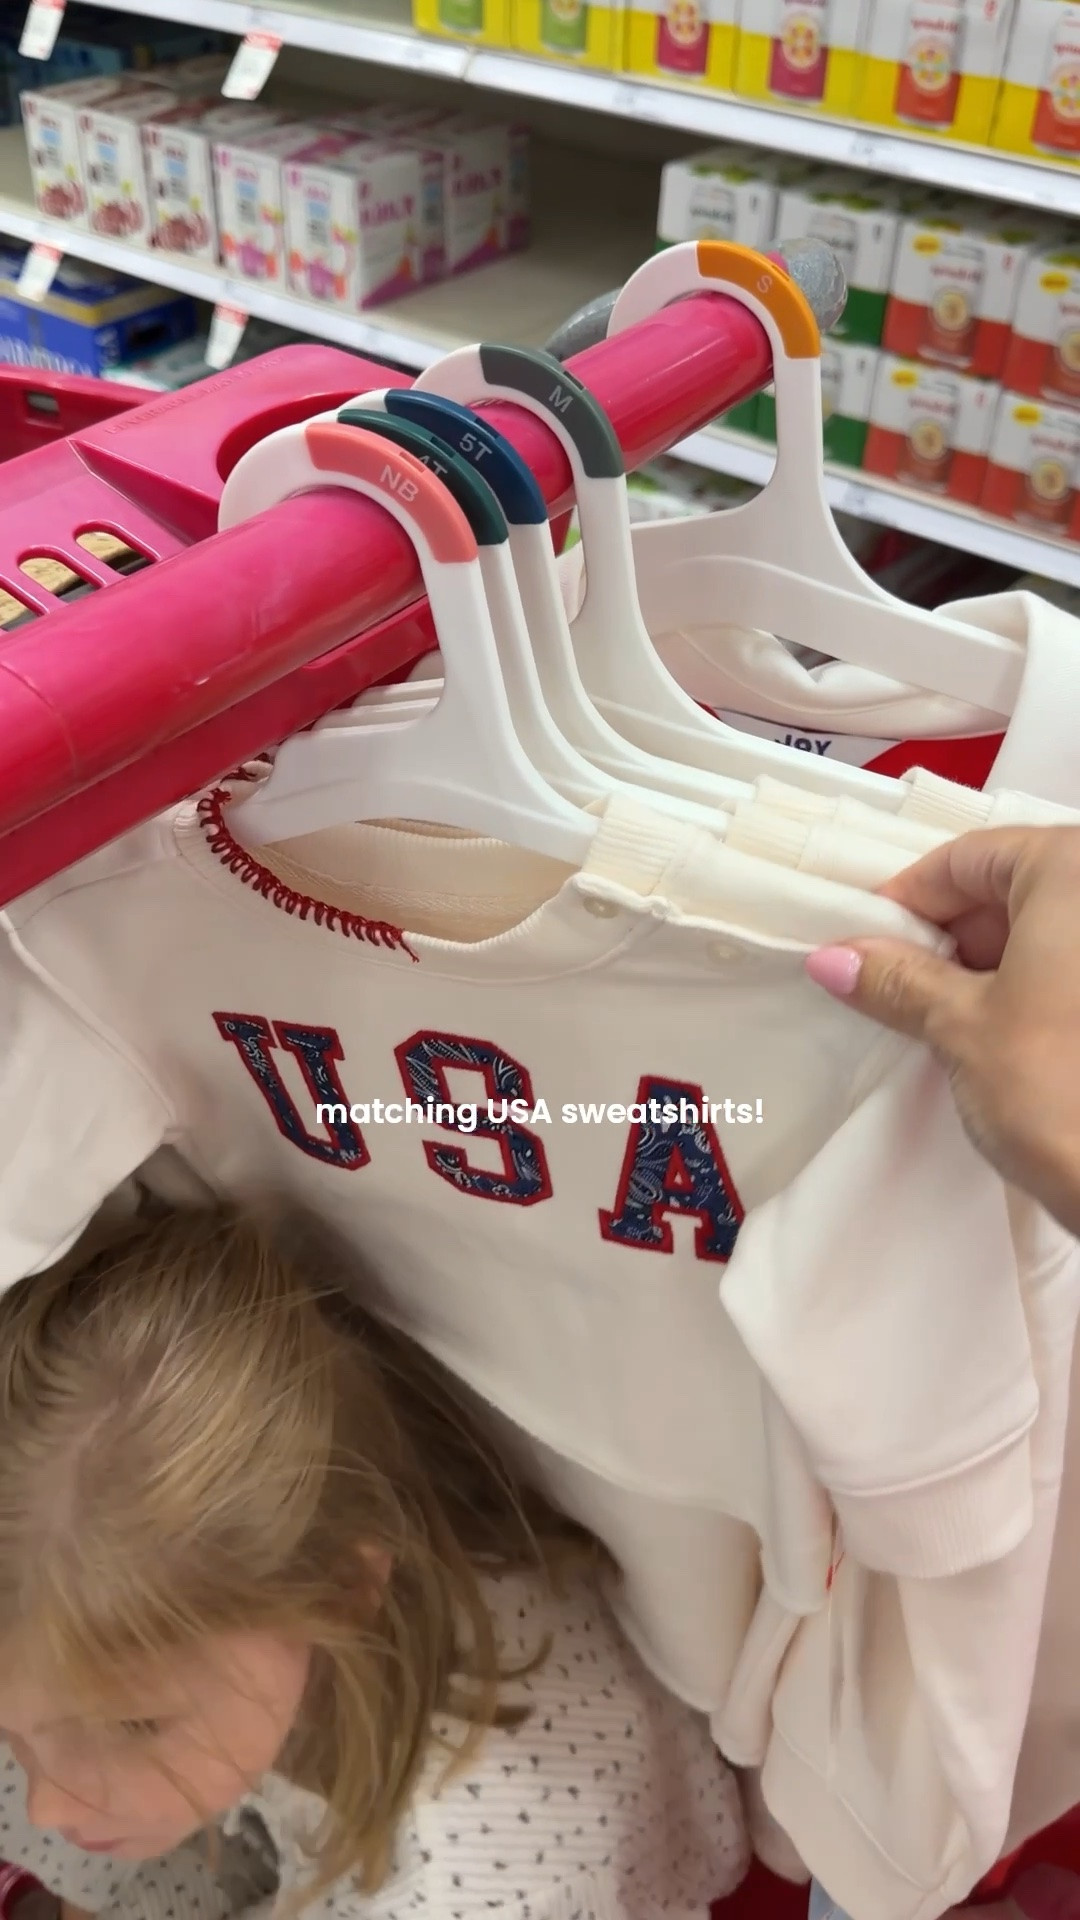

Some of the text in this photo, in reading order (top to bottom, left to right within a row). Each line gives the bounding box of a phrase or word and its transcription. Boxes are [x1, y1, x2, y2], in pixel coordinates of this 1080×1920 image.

[757, 275, 773, 293] S
[548, 384, 574, 413] M
[459, 432, 493, 461] 5T
[380, 464, 419, 503] NB
[211, 1011, 746, 1264] USA
